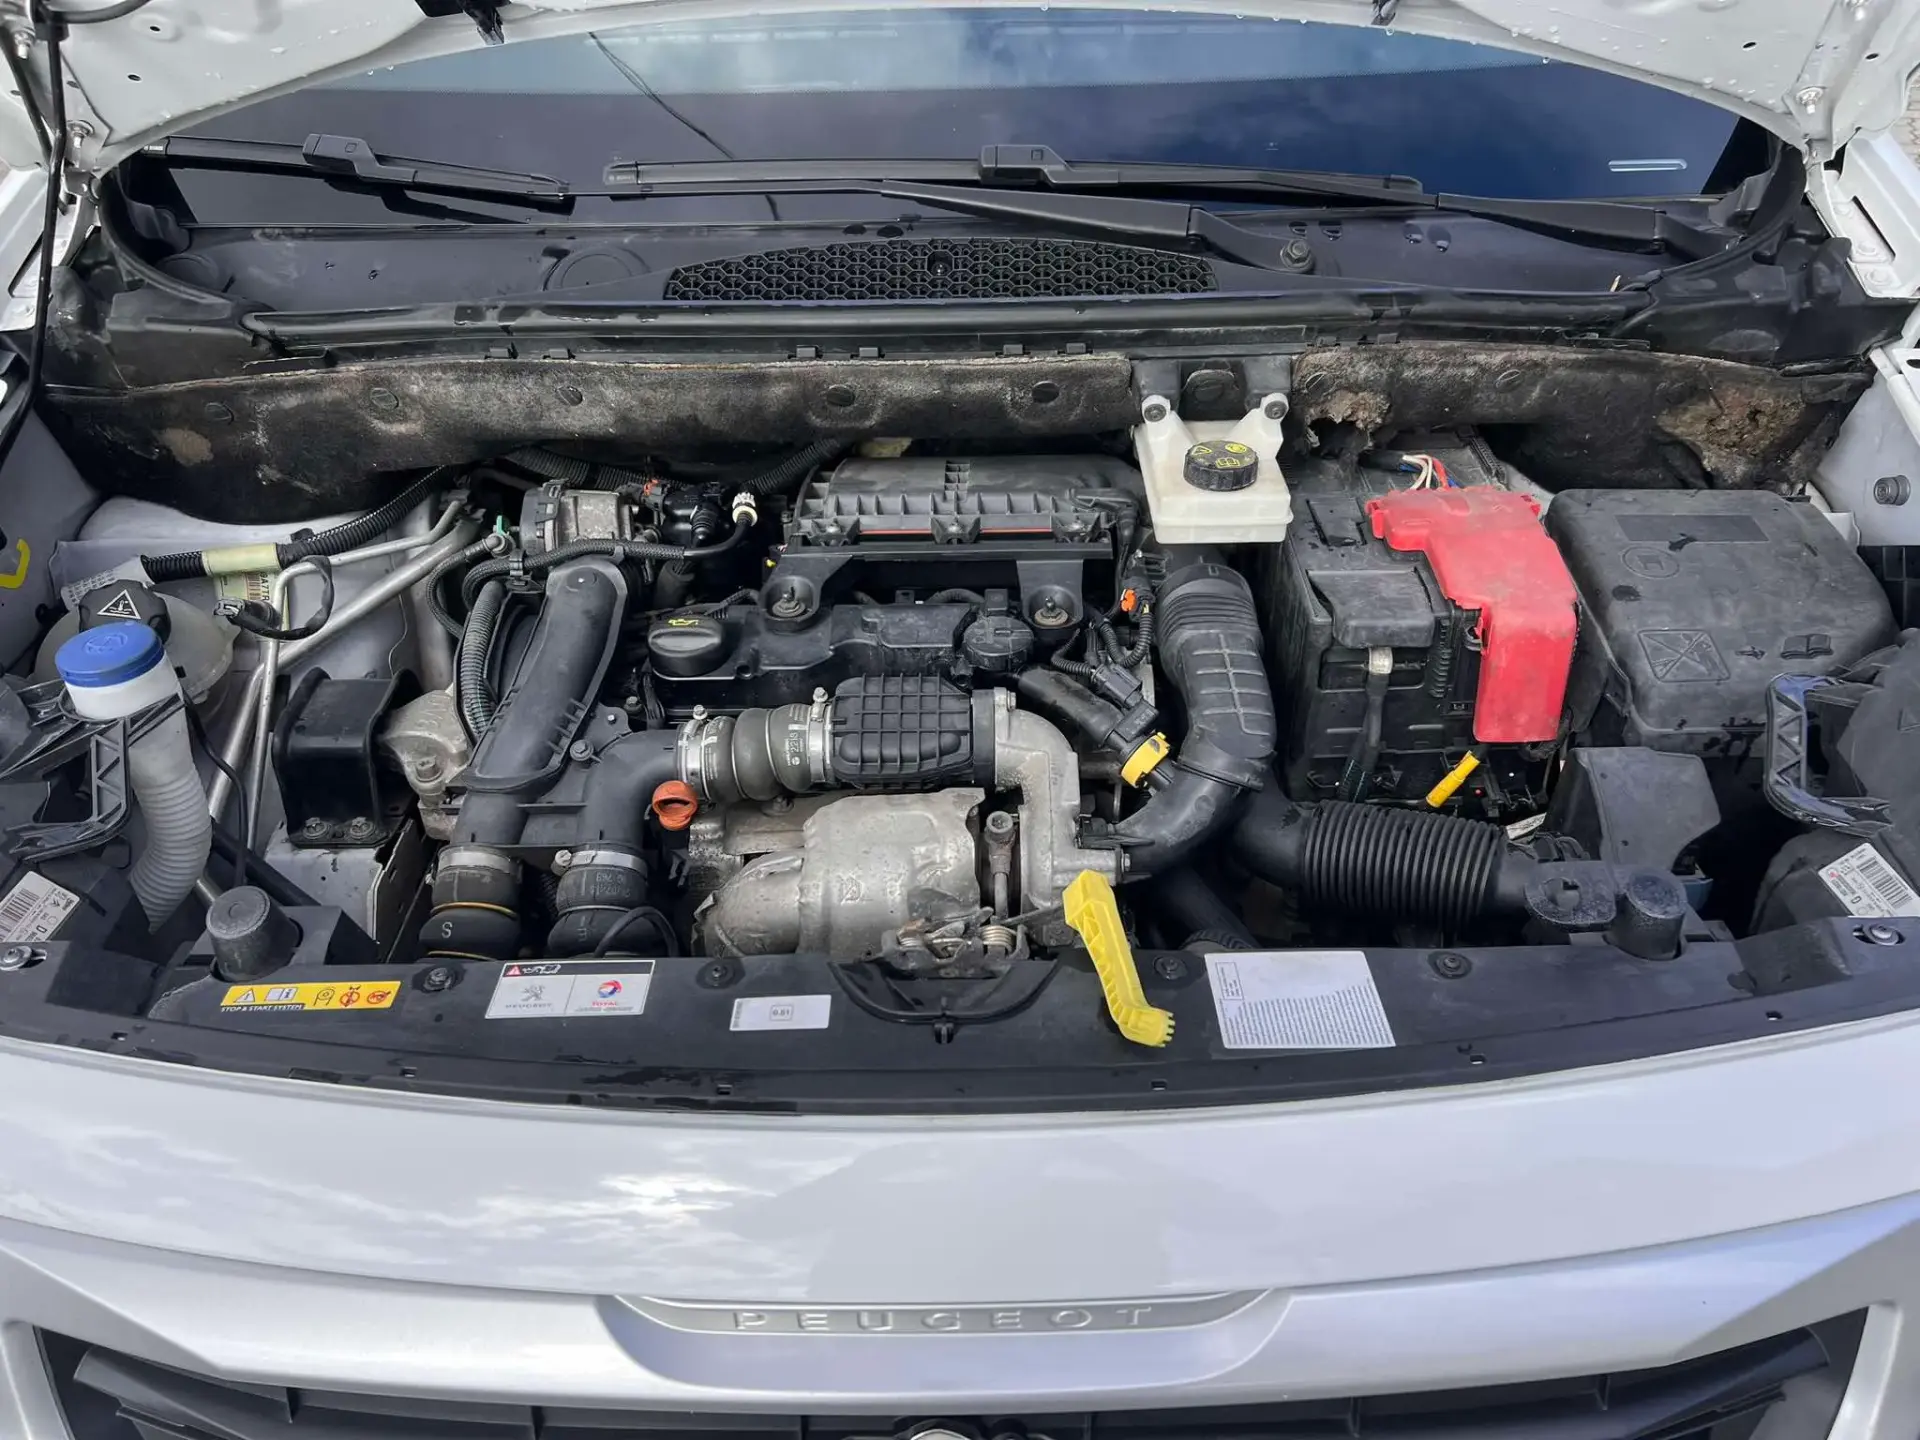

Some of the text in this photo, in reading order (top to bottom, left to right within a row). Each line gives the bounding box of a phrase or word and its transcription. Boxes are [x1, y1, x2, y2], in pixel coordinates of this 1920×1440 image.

[441, 921, 453, 938] S
[249, 1004, 272, 1012] START
[735, 1306, 1153, 1331] PEUGEOT
